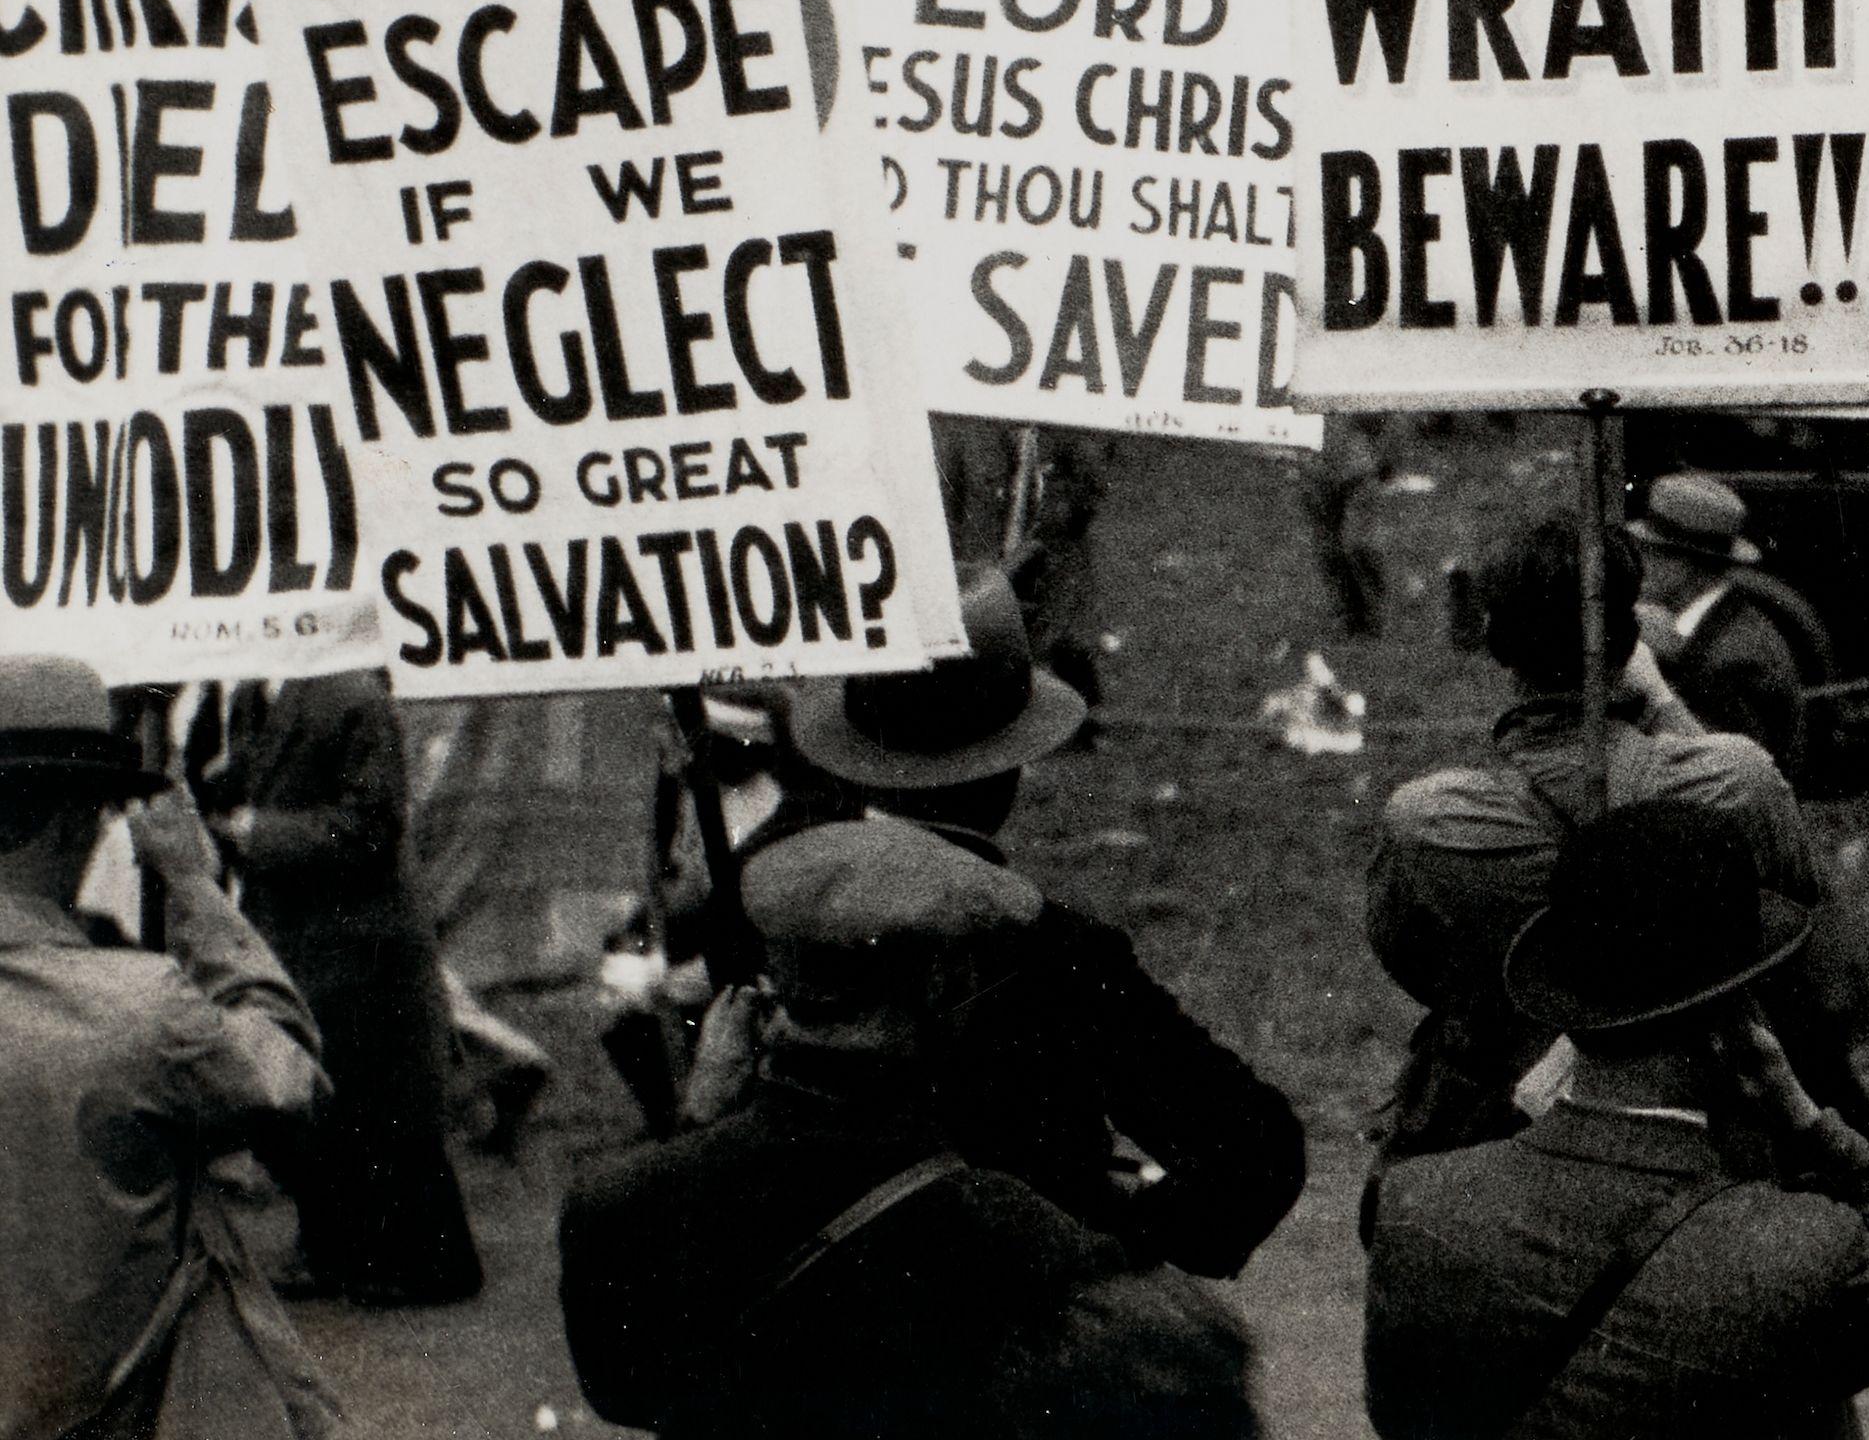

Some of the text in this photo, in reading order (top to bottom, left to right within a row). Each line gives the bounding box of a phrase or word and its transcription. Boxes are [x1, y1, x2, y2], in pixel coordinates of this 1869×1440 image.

[862, 44, 1295, 161] ESUS CHRIS
[400, 149, 734, 244] IF WE
[937, 156, 1104, 231] THOU
[1320, 131, 1865, 333] BEWARE!!
[141, 281, 326, 376] THE
[329, 230, 851, 443] NEGLECT
[432, 431, 810, 517] SO GREAT
[379, 513, 898, 671] SALVATION?
